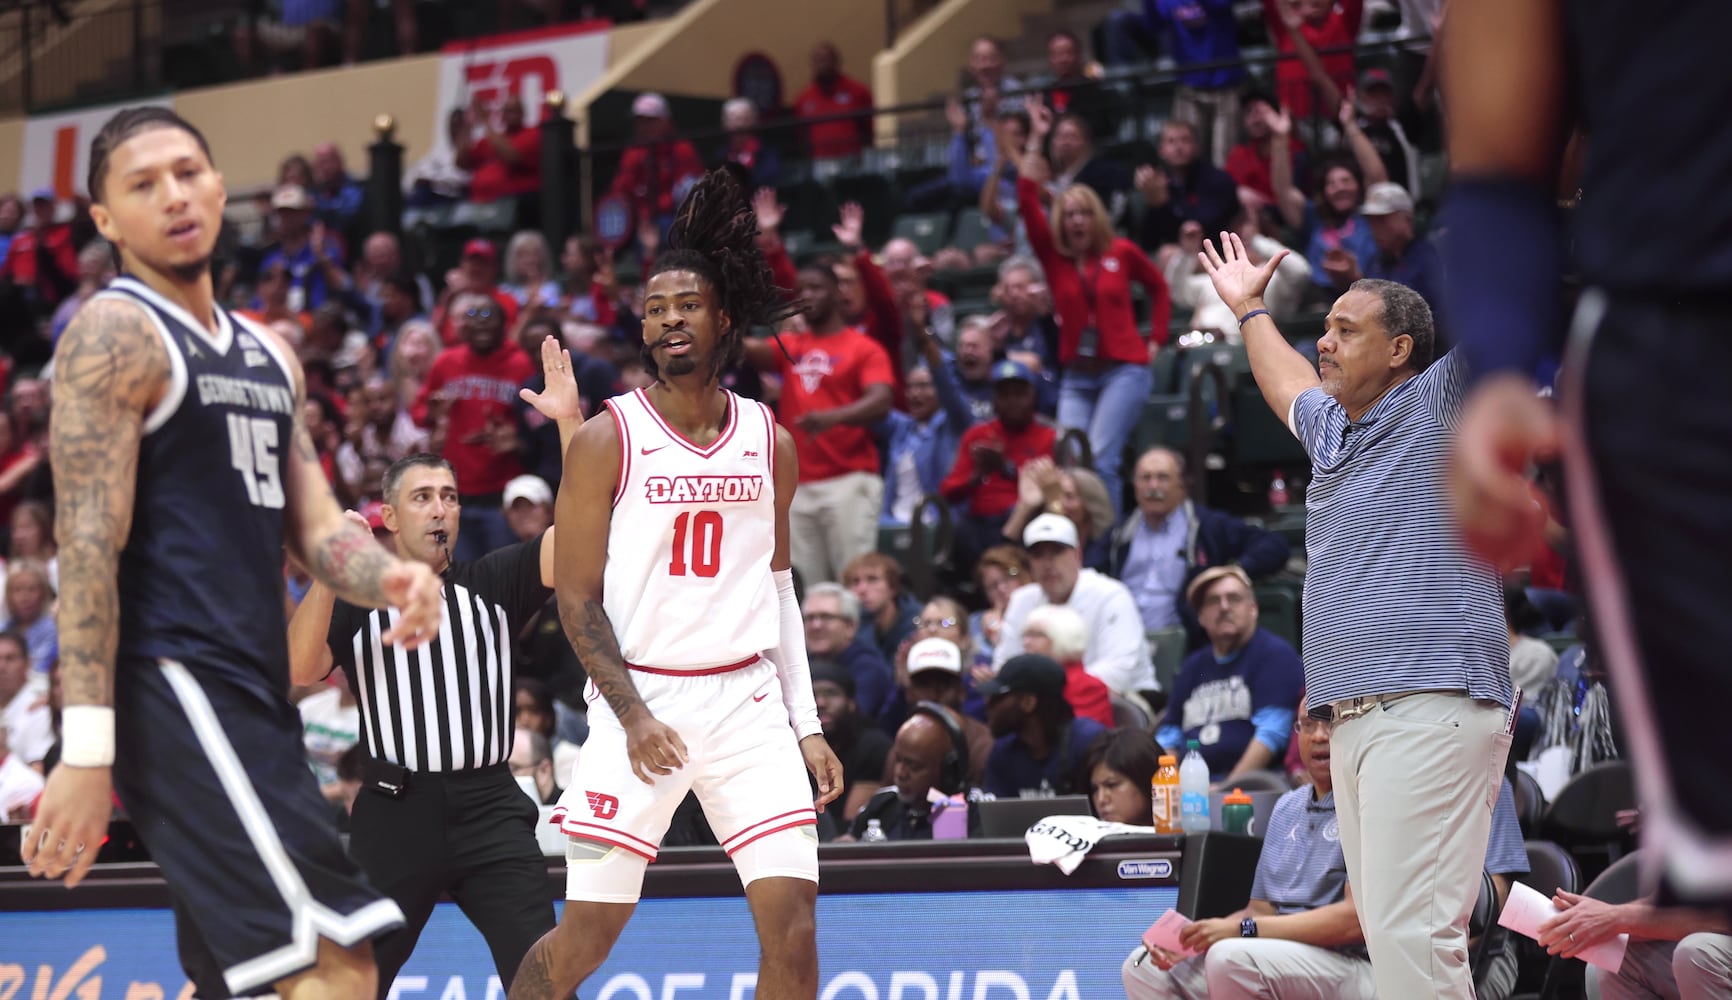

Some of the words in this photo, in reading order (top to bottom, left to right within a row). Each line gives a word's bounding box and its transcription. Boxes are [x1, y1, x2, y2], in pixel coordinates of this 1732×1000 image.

[197, 375, 293, 415] GEORGETOWN
[227, 412, 285, 509] 45
[645, 475, 763, 504] DAYTON
[669, 510, 723, 578] 10
[1122, 863, 1137, 875] Van
[1138, 863, 1168, 876] Wagner
